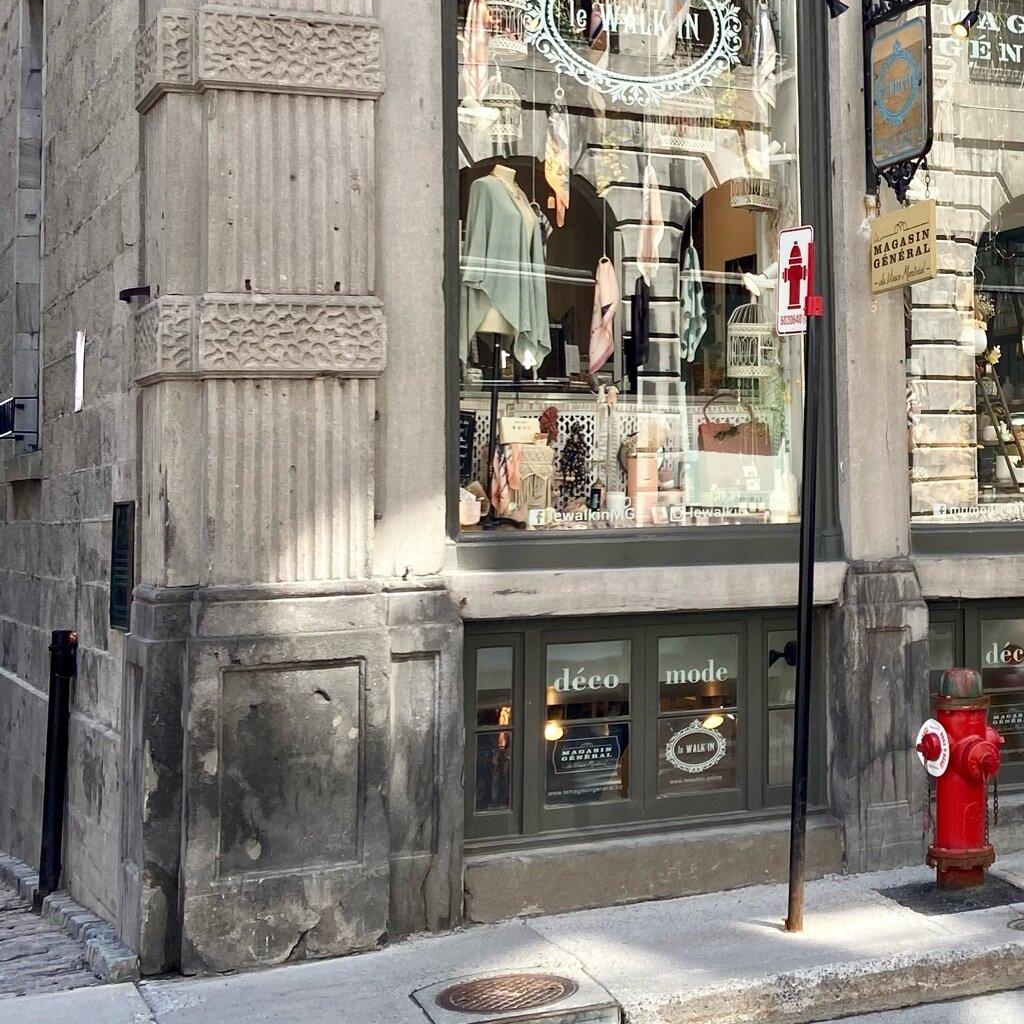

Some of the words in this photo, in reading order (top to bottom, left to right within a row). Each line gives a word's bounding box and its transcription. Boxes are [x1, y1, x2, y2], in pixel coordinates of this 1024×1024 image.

[569, 0, 587, 27] le
[873, 228, 930, 256] MAGASIN
[873, 243, 931, 269] GÉNÉRAL
[549, 507, 635, 522] ewalkinMG
[554, 667, 619, 692] déco
[665, 659, 728, 685] mode
[561, 747, 612, 756] MAGASIN
[561, 753, 612, 762] GÉNÉRAL
[686, 742, 715, 754] WALK-IN
